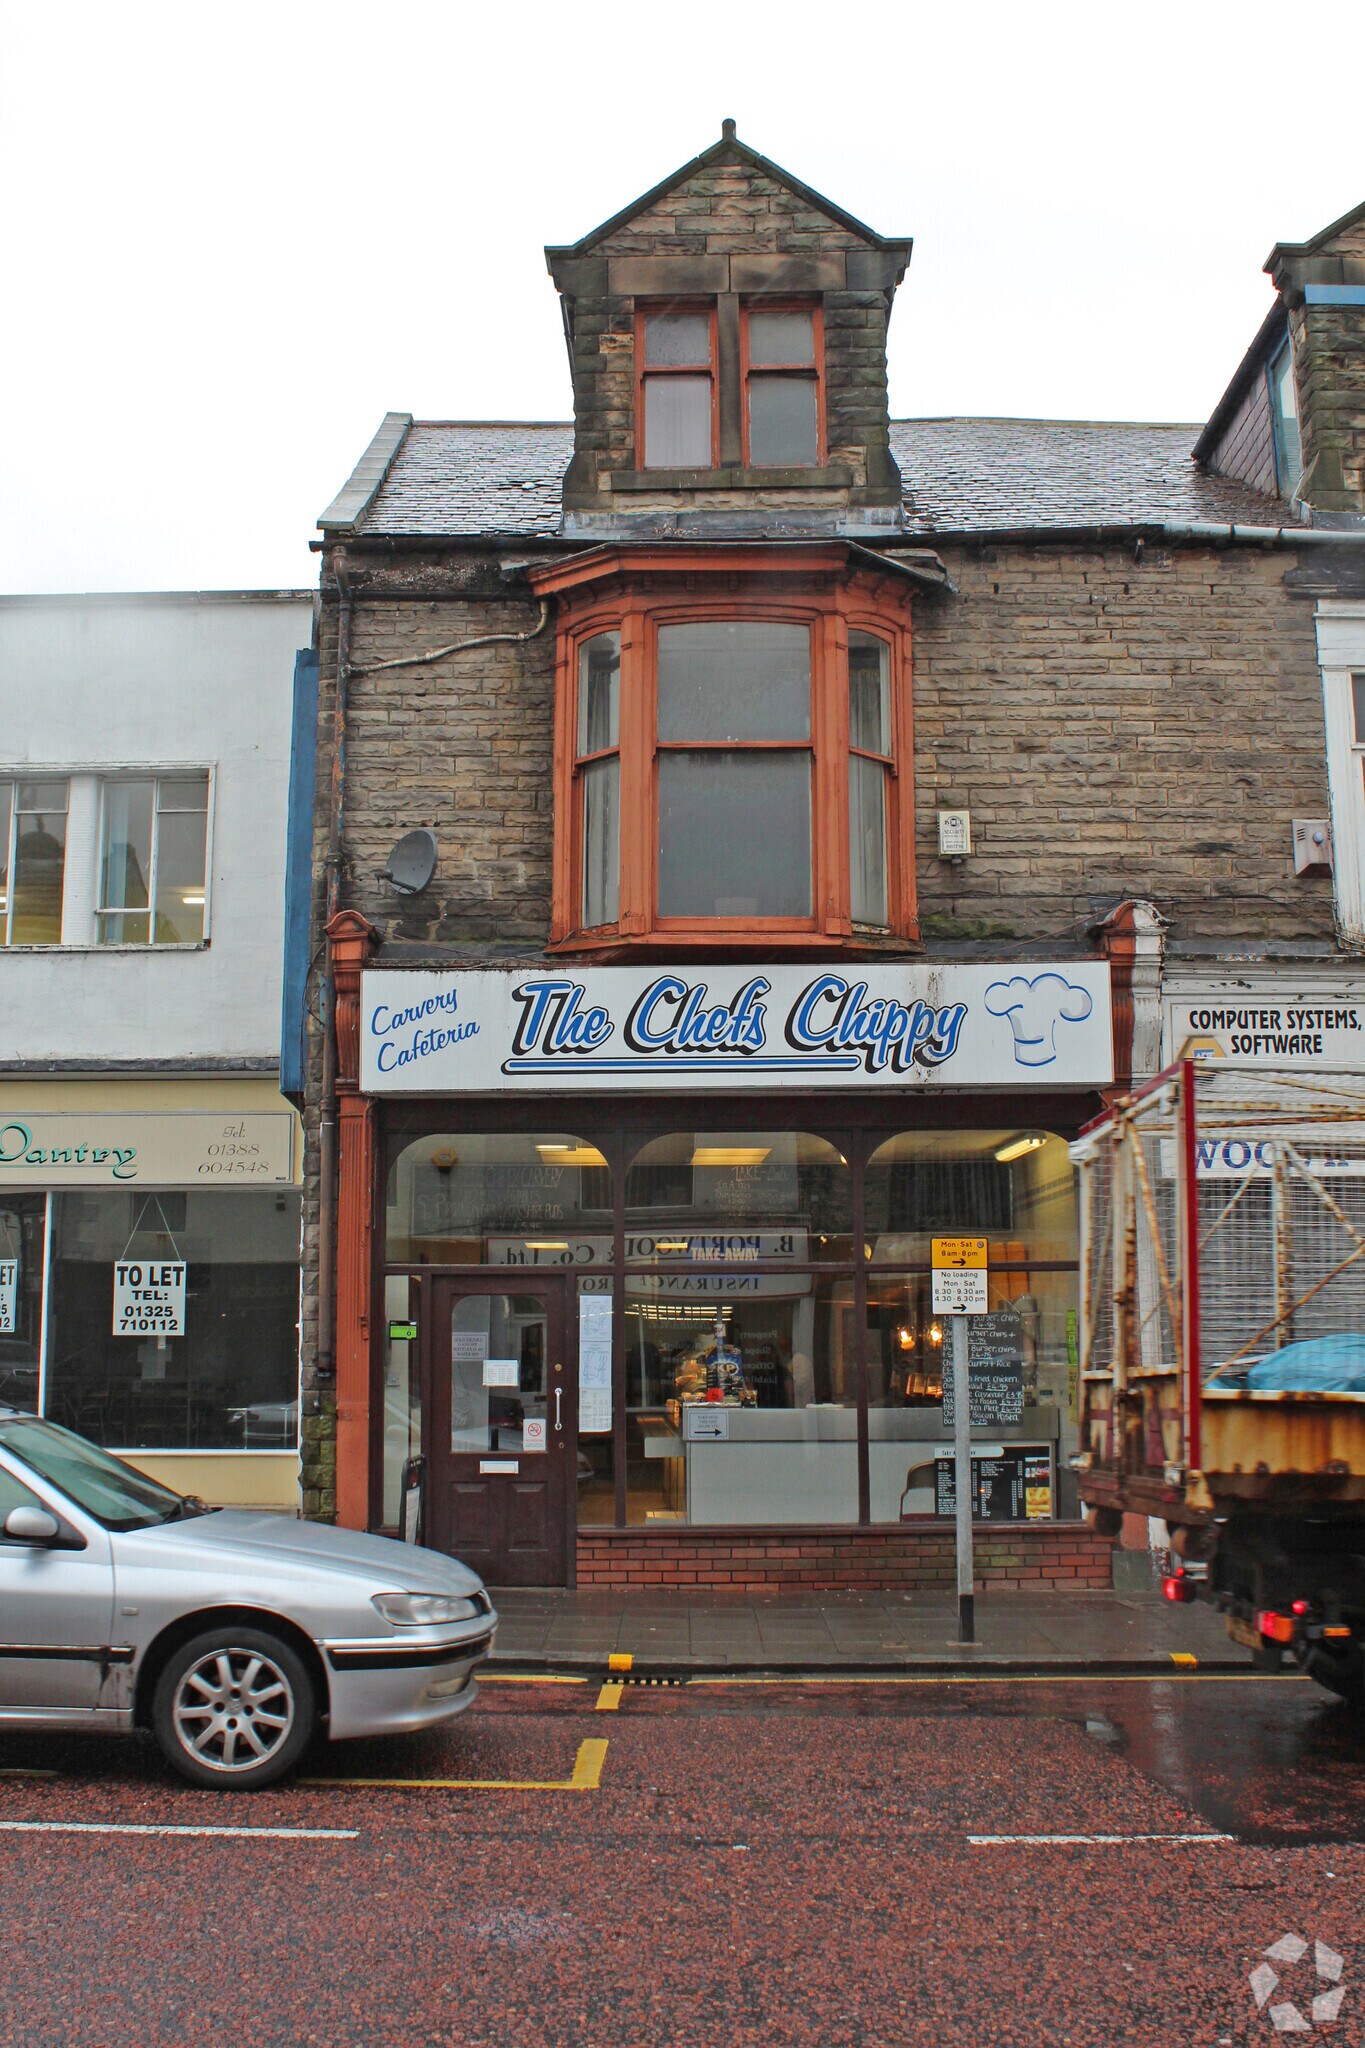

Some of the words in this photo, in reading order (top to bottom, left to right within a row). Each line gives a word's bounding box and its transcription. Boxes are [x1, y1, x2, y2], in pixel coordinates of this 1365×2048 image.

[371, 988, 458, 1036] Carvery
[512, 979, 615, 1055] The
[623, 975, 771, 1055] Chefs
[784, 973, 968, 1074] Chippy
[1189, 1010, 1282, 1031] COMPUTER
[1287, 1010, 1362, 1031] SYSTEMS,
[376, 1020, 481, 1073] Cafeteria
[1231, 1034, 1323, 1056] SOFTWARE
[222, 1121, 246, 1138] Tel:
[207, 1143, 260, 1157] 01388
[198, 1161, 269, 1175] 604548
[691, 1247, 760, 1261] TAKE-AWAY
[0, 1265, 15, 1286] ET
[117, 1265, 143, 1287] TO
[150, 1265, 185, 1287] LET
[953, 1271, 979, 1279] loading
[132, 1290, 169, 1301] TEL:
[124, 1305, 174, 1318] 01325
[119, 1319, 179, 1331] 710112
[972, 1411, 994, 1419] Bacon
